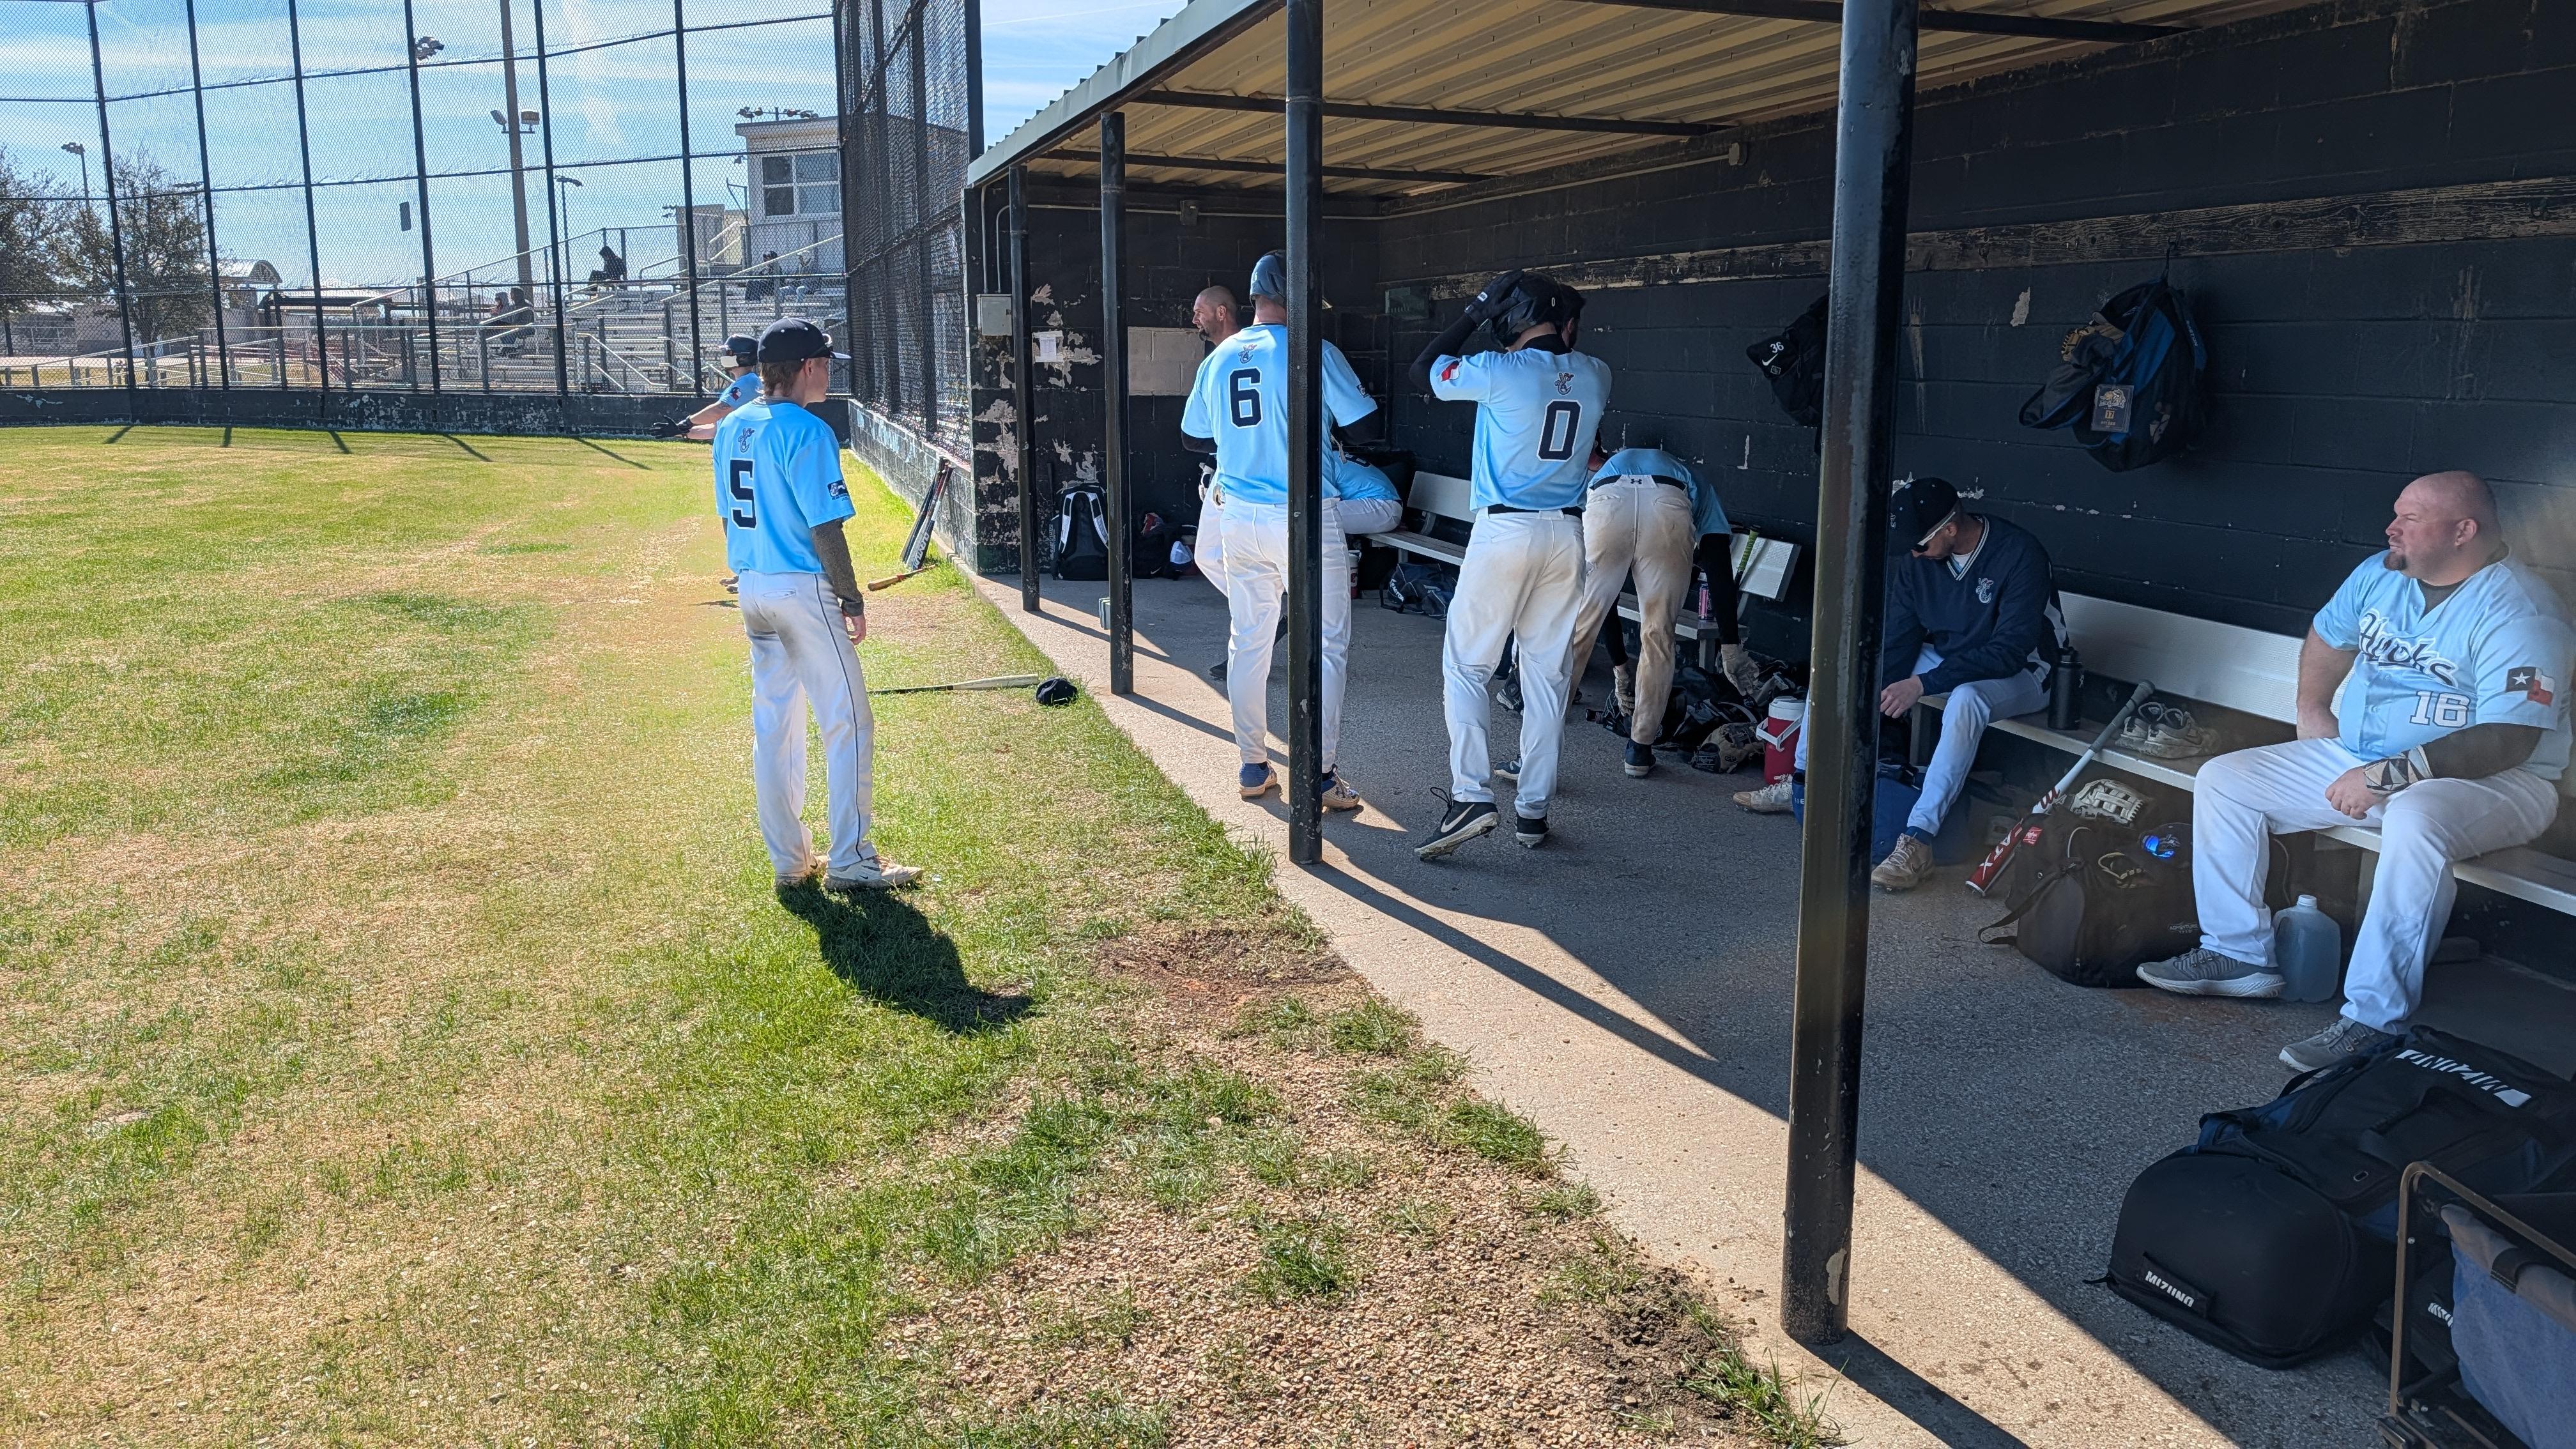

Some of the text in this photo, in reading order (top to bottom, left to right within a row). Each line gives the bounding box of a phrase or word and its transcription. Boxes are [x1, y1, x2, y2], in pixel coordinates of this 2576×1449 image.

[1770, 341, 1784, 353] 36
[1229, 366, 1263, 429] 6
[1536, 399, 1583, 462] 0
[729, 457, 758, 531] 5
[2409, 690, 2471, 728] 16
